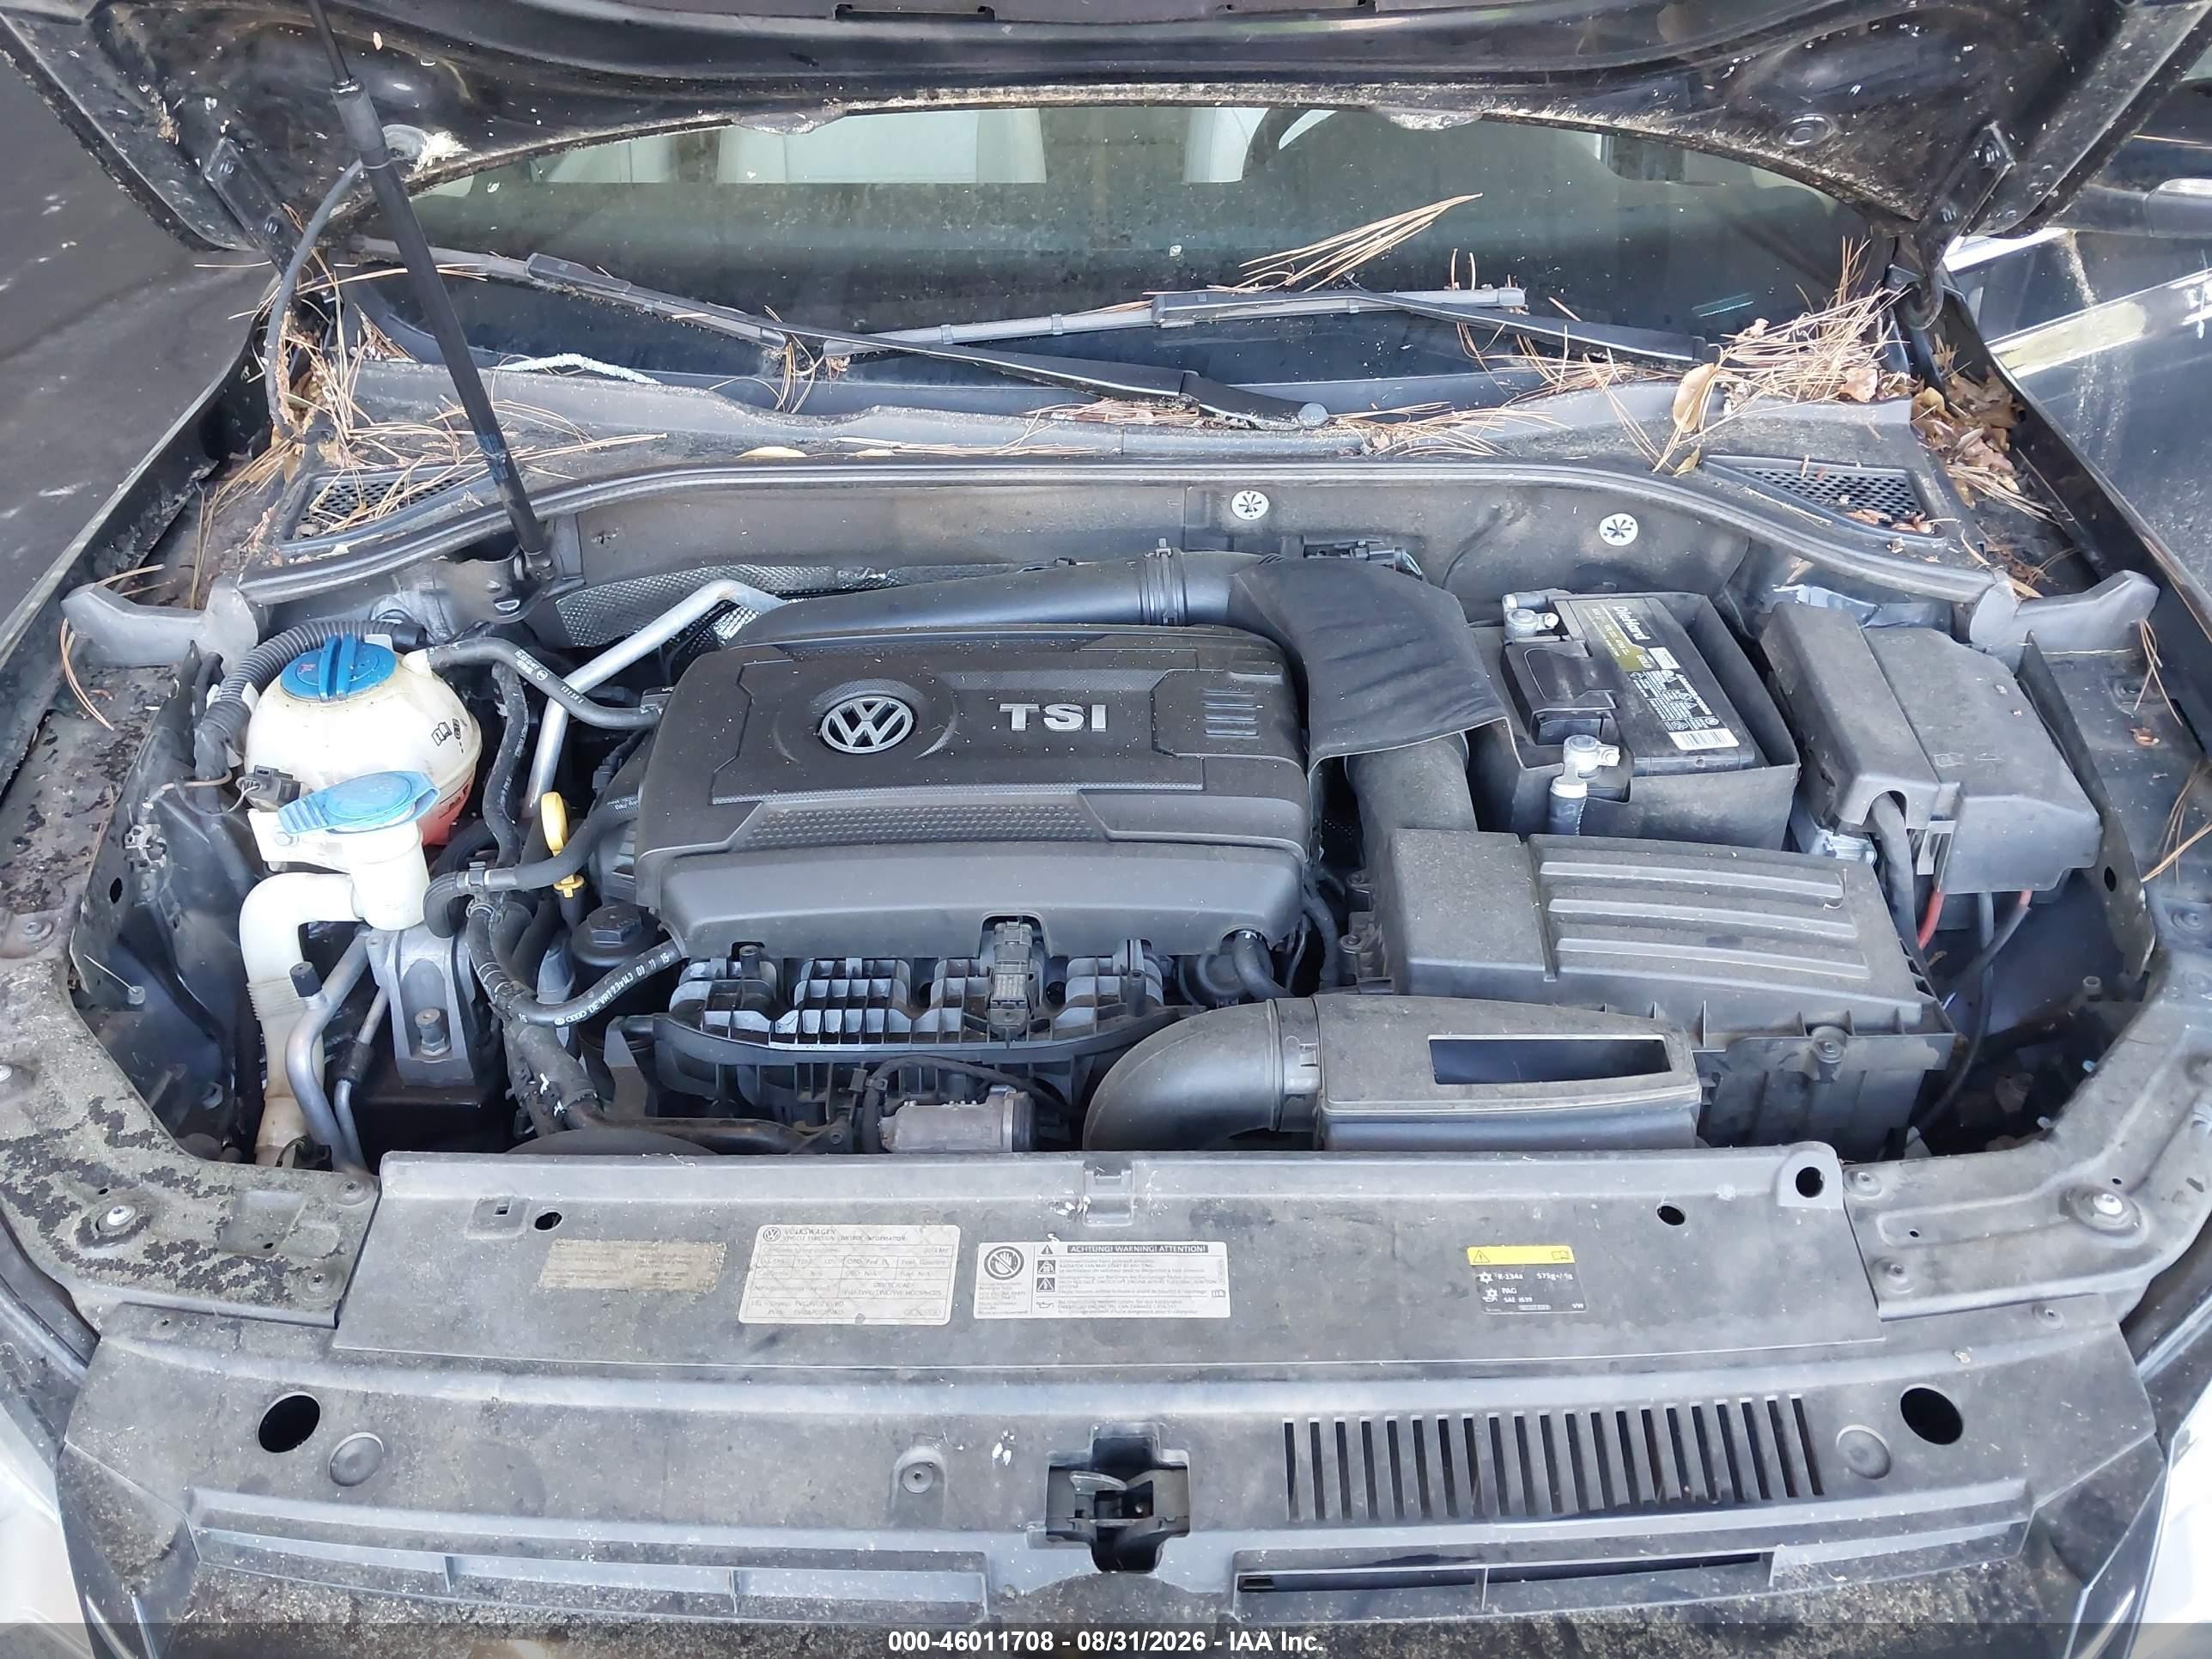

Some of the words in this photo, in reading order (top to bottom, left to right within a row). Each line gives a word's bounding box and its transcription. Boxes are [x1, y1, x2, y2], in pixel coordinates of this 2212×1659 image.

[1613, 606, 1651, 641] DieHard
[820, 694, 917, 755] VW
[999, 702, 1109, 732] TSI
[659, 952, 670, 964] 15
